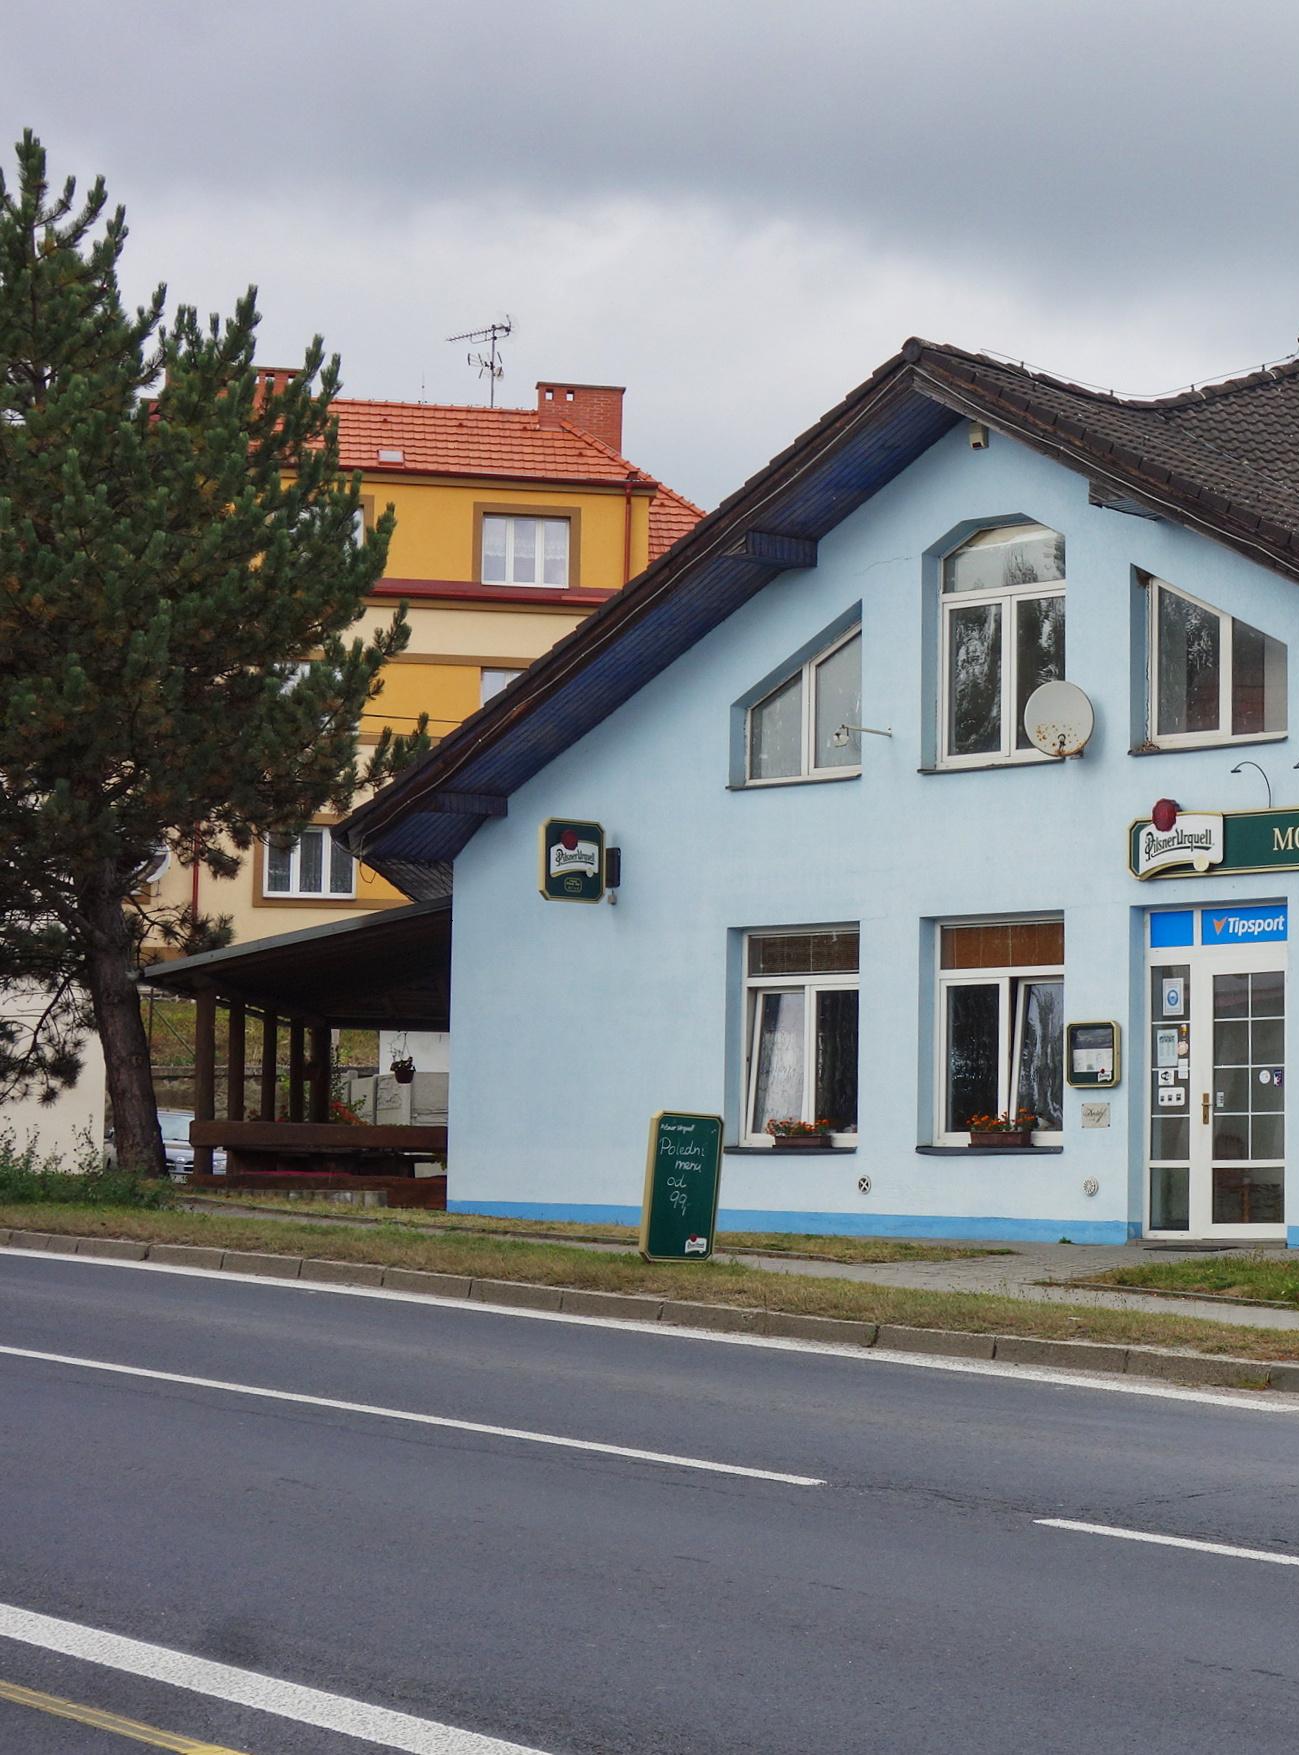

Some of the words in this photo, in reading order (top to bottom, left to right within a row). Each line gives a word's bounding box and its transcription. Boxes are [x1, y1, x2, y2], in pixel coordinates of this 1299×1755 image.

[1145, 831, 1175, 862] Pilsner
[1175, 828, 1212, 852] Urquell
[1228, 915, 1285, 936] Tipsport
[667, 1174, 687, 1188] od
